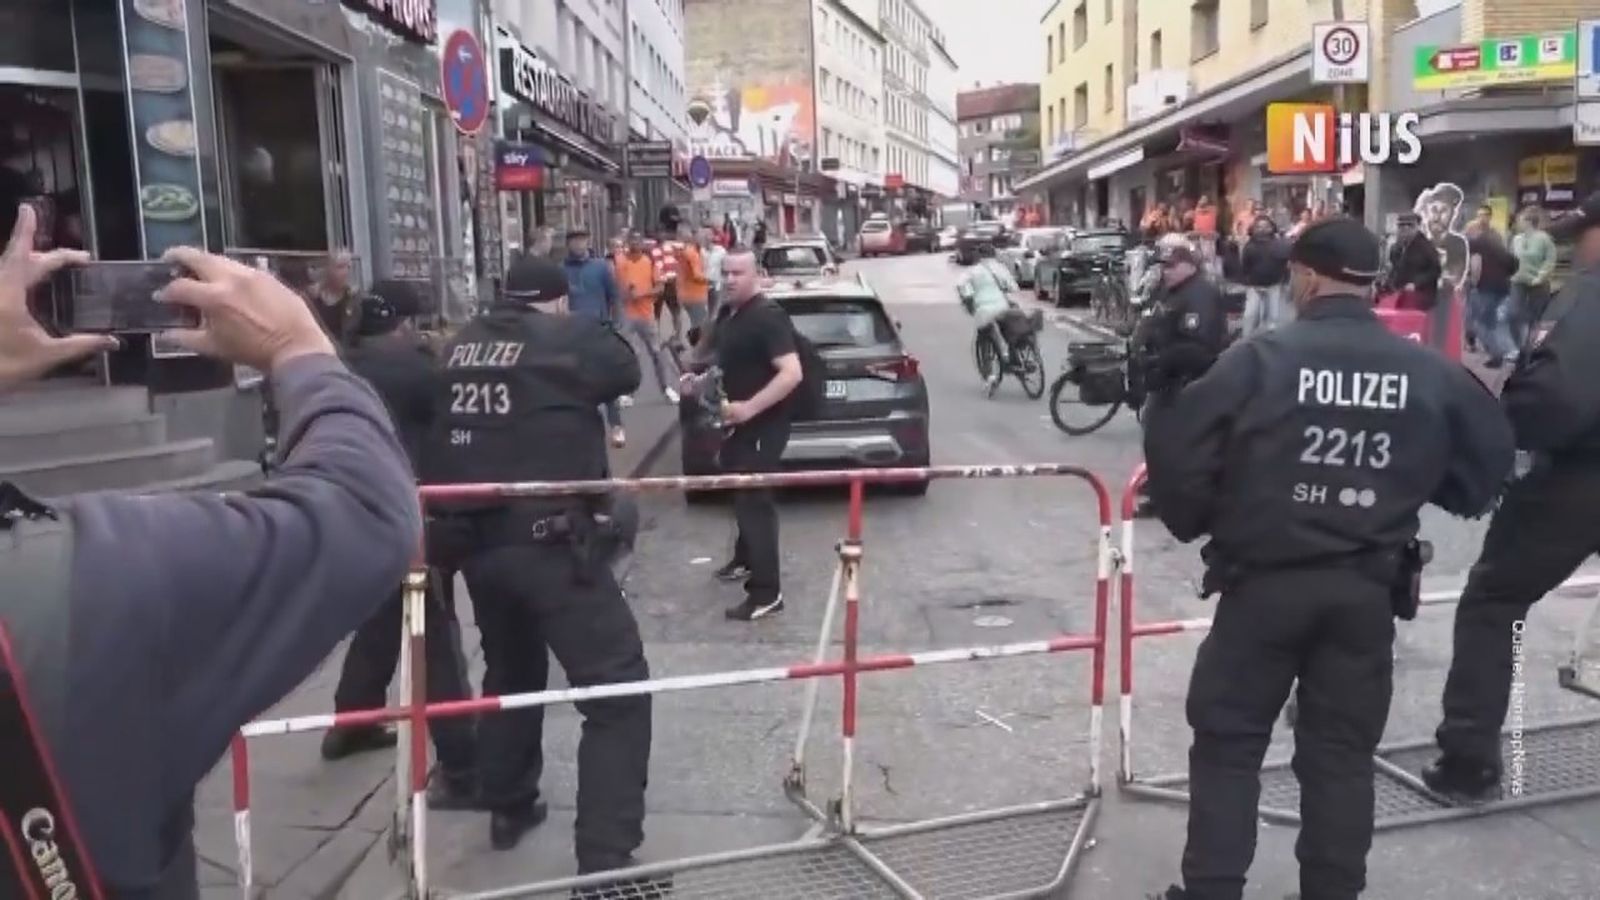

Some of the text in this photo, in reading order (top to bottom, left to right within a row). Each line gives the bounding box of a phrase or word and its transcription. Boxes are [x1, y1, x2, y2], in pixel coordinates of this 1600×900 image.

[1331, 37, 1352, 56] 30
[503, 151, 529, 166] sky
[448, 342, 524, 369] POLIZEI
[450, 382, 512, 415] 2213
[1297, 367, 1409, 410] POLIZEI
[450, 429, 472, 446] SH
[1299, 425, 1392, 470] 2213
[1292, 482, 1329, 505] SH
[21, 807, 79, 900] Cano
